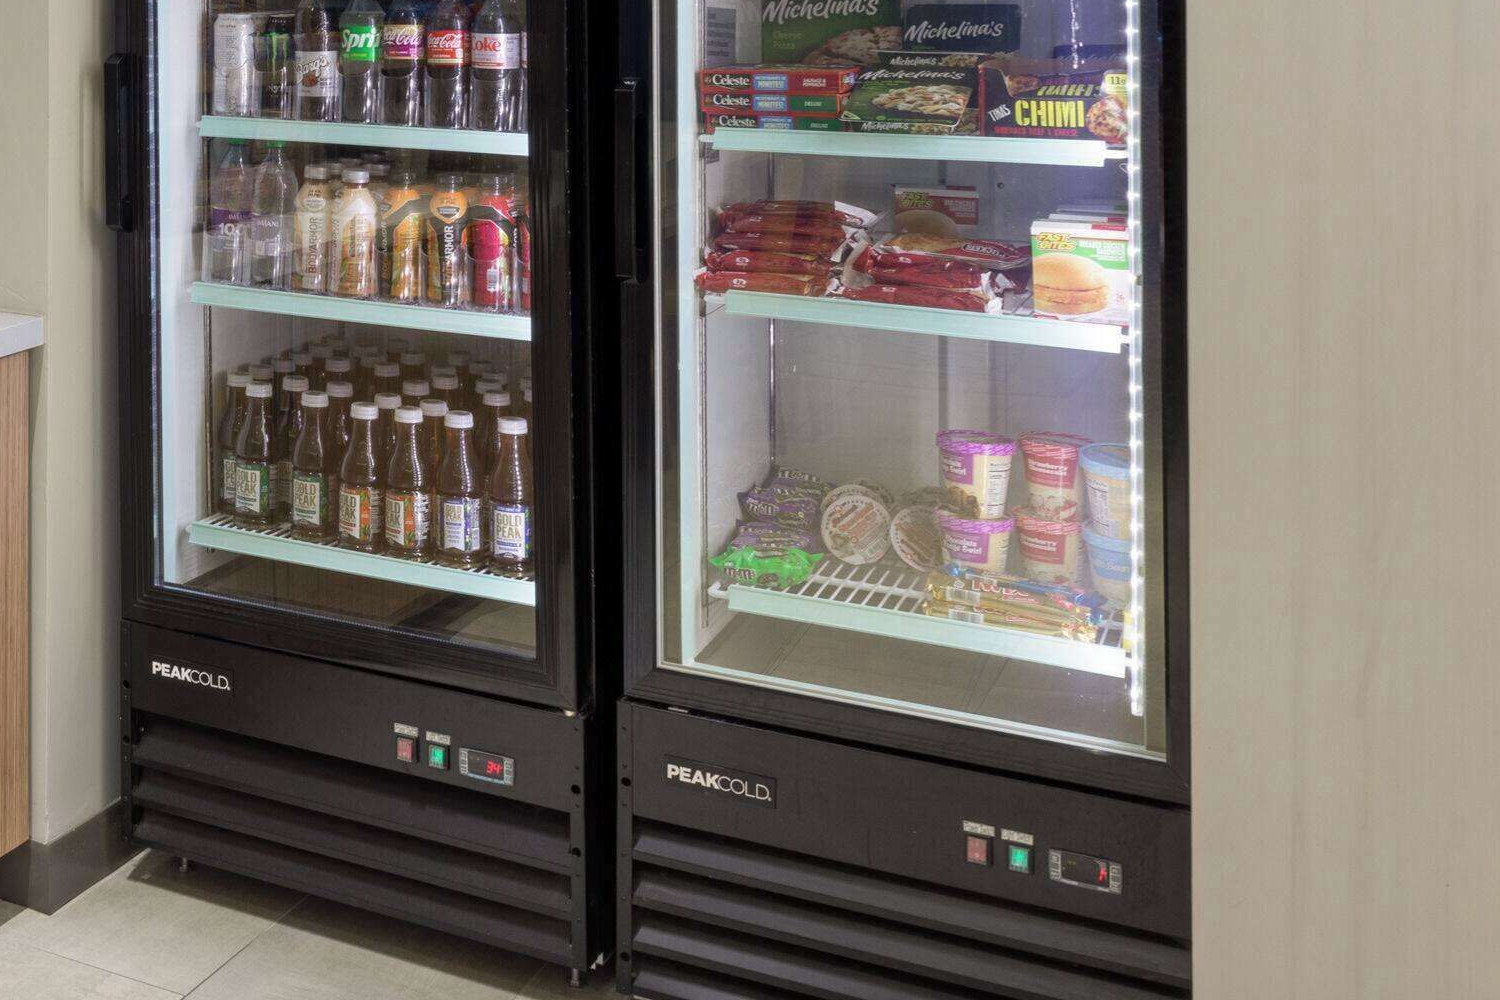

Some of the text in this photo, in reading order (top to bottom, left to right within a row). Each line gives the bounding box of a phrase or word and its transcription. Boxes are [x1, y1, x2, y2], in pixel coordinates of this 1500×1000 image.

[904, 20, 1004, 44] Michelina's
[891, 56, 938, 67] Michelina's
[712, 73, 750, 87] Celeste
[858, 69, 966, 81] Michelina's
[713, 94, 750, 107] Celeste
[1014, 99, 1085, 128] CHIMI
[719, 115, 756, 127] Celeste
[307, 218, 318, 274] BODYARMOR
[496, 526, 522, 540] PEAK
[151, 661, 231, 692] PEAKCOLD
[666, 763, 773, 803] PEAKCOLD
